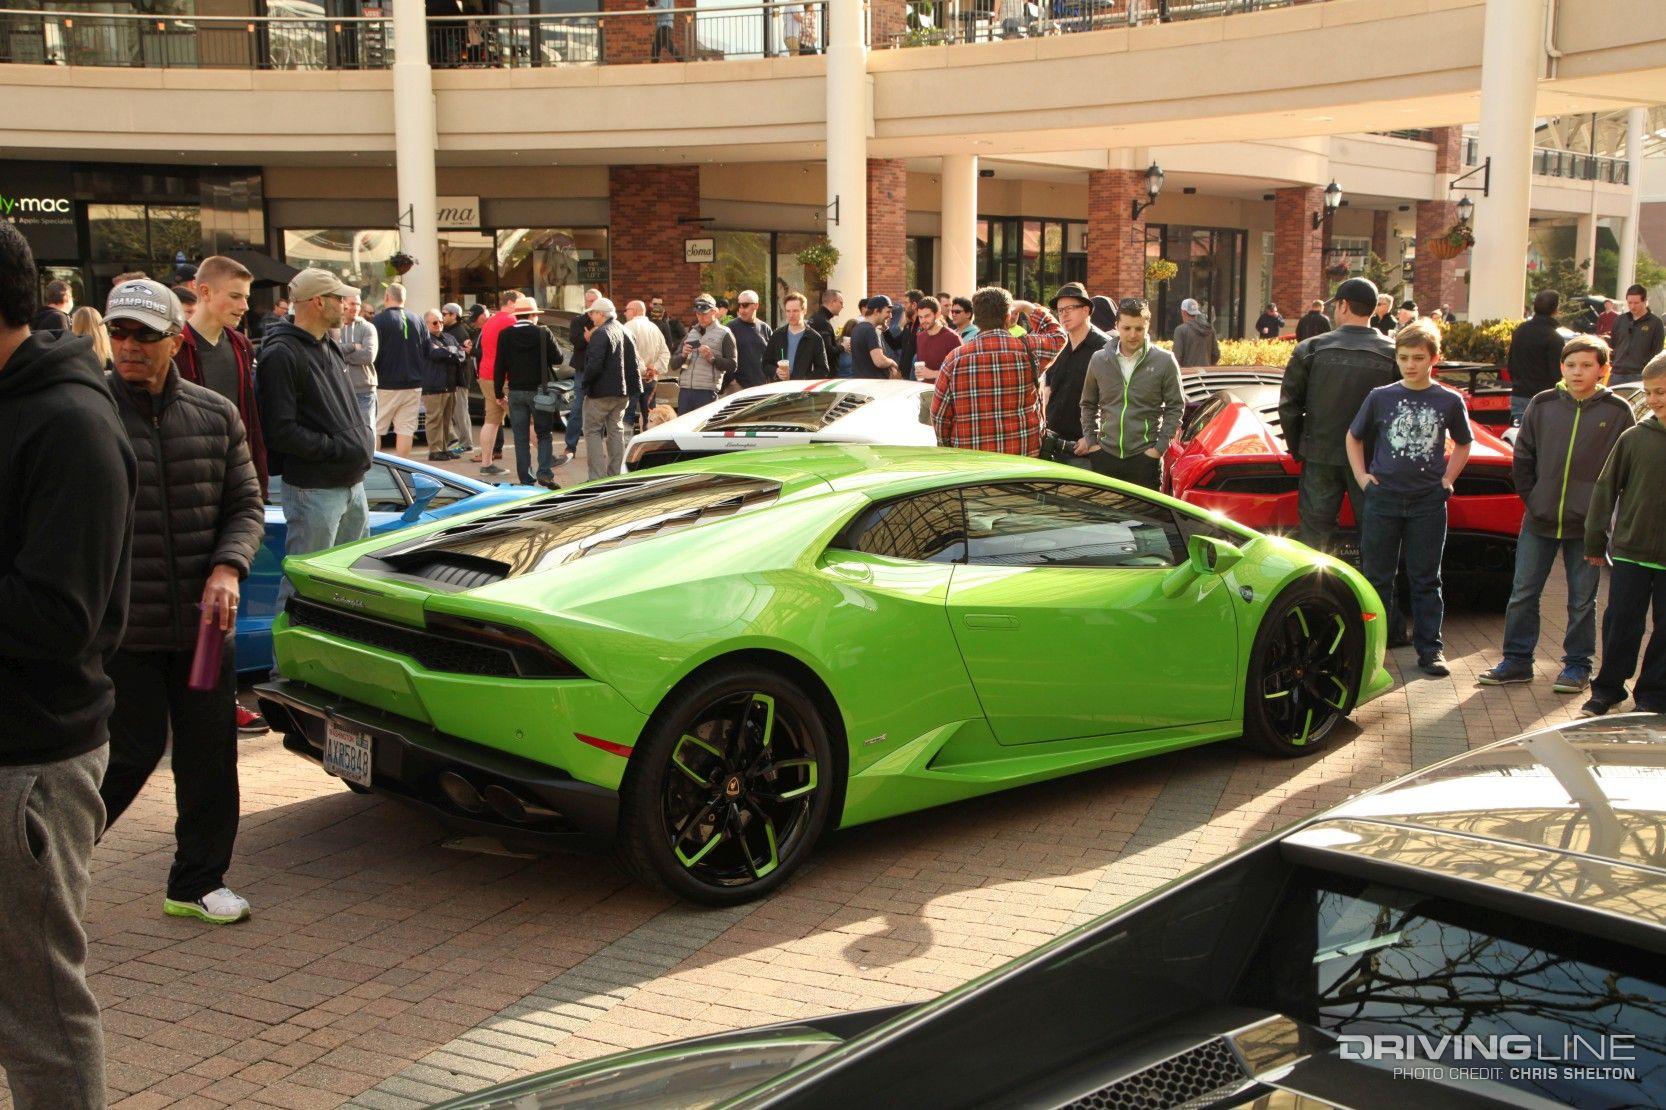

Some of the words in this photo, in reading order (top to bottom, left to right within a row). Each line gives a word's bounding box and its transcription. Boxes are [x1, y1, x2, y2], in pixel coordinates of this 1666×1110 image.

[19, 217, 40, 225] Apple
[436, 208, 476, 222] ma
[687, 244, 713, 257] Soma
[108, 297, 168, 315] CHAMPIONS
